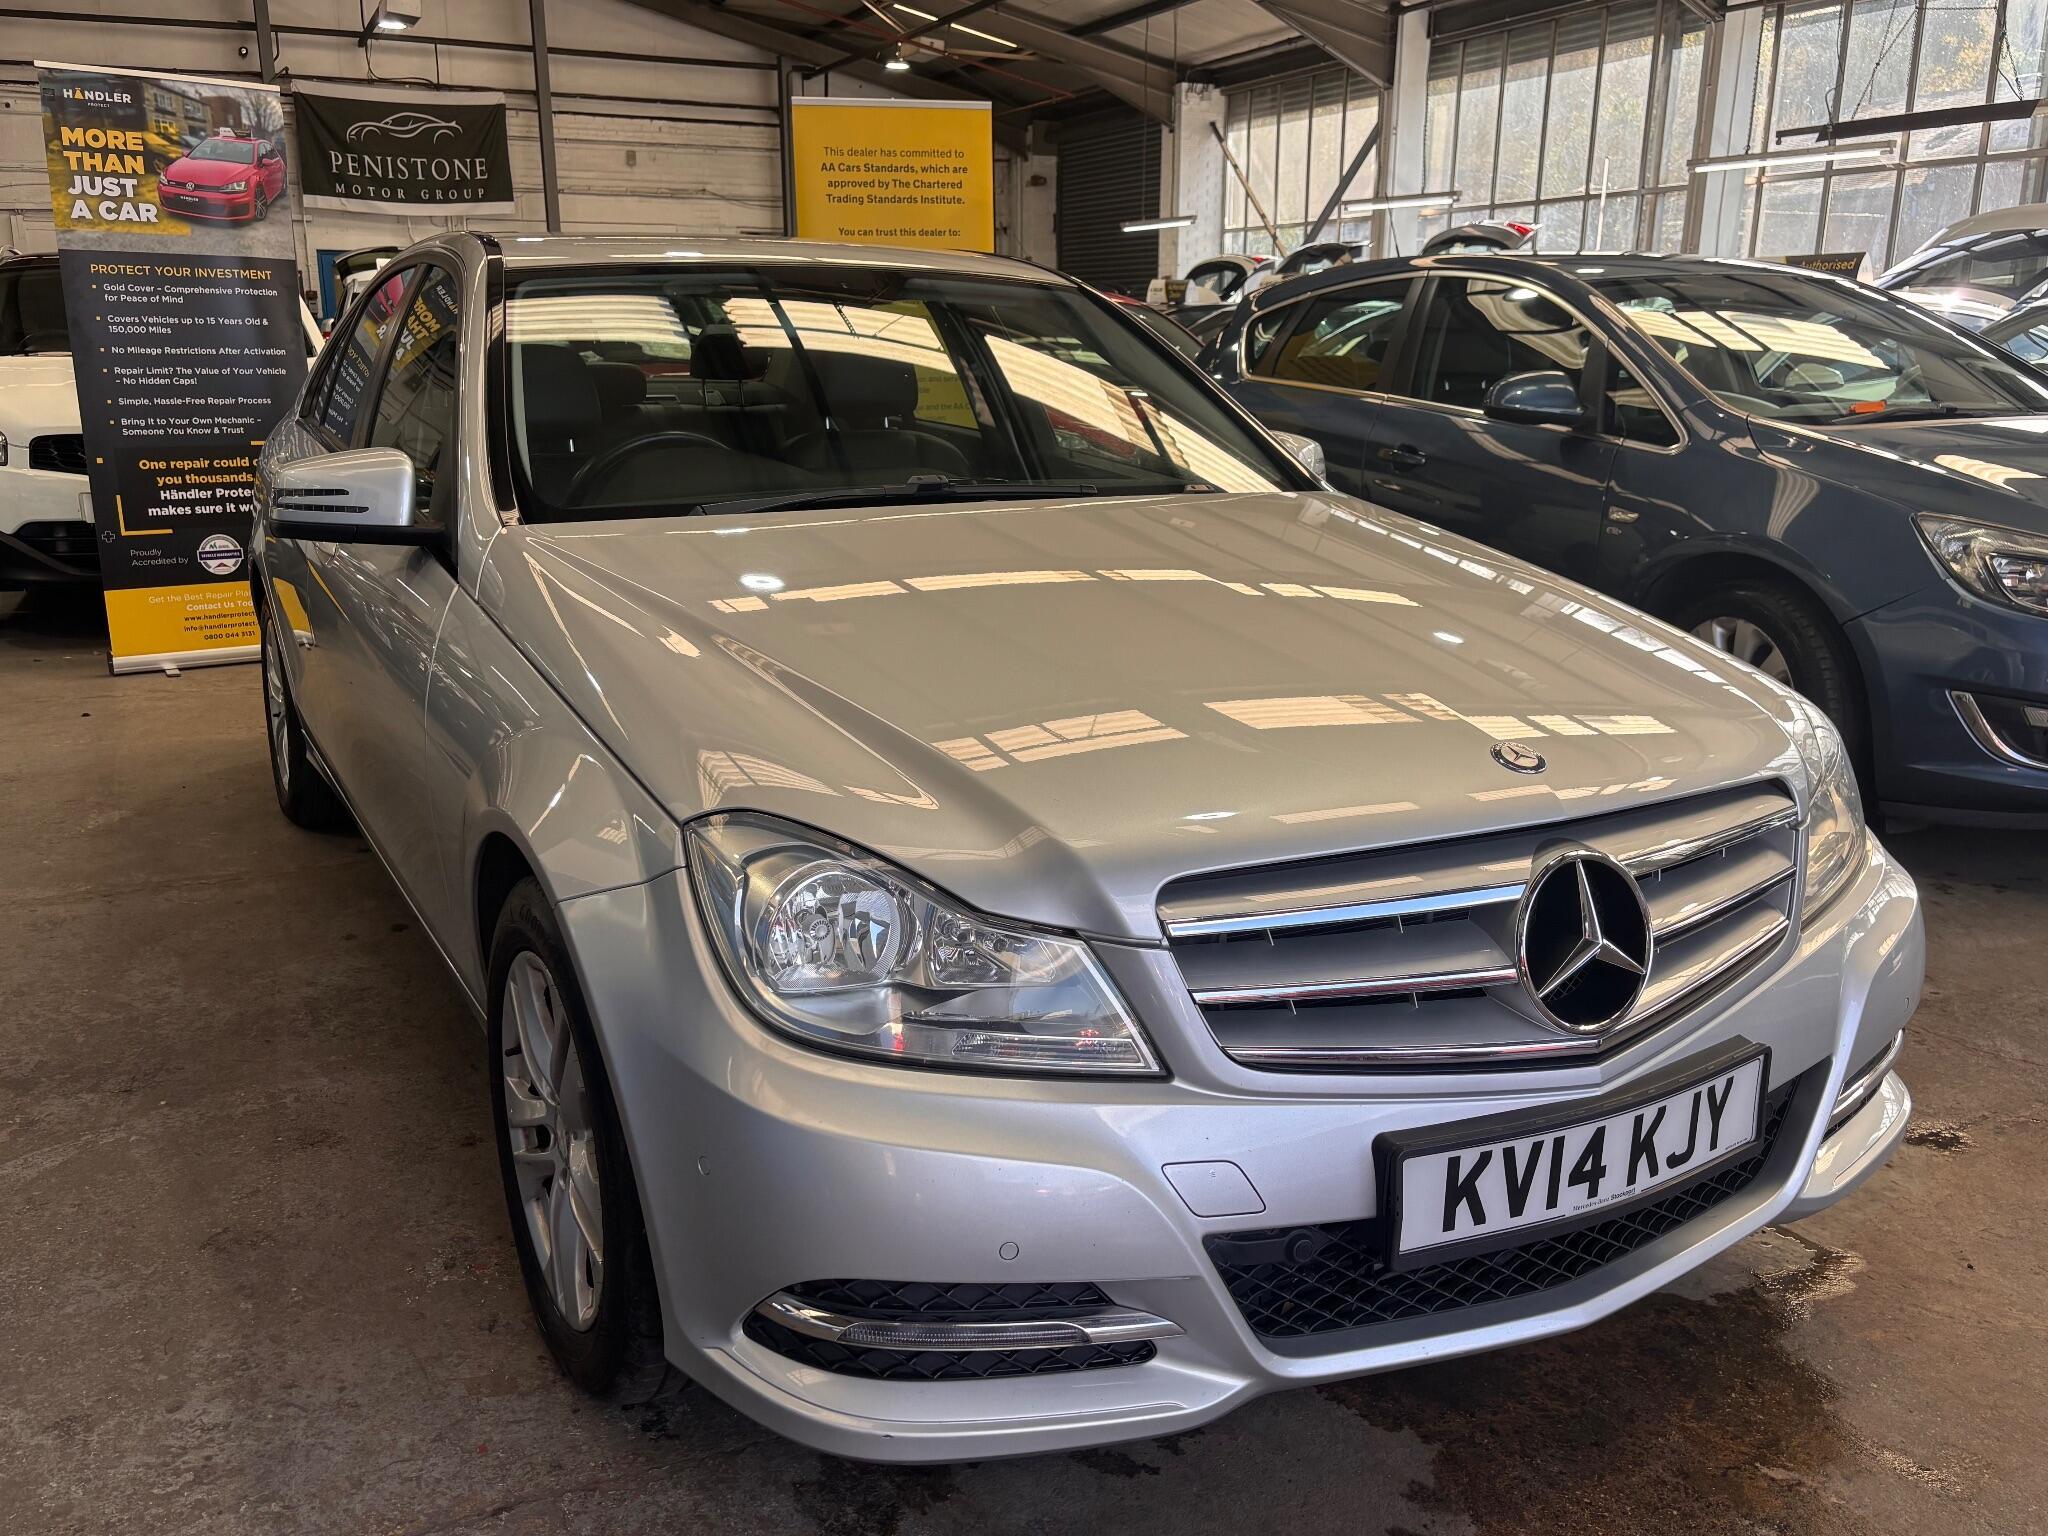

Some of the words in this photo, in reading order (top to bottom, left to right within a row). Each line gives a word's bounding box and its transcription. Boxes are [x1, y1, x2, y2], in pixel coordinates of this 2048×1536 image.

[60, 126, 144, 151] MORE
[824, 147, 844, 157] This
[847, 148, 877, 157] dealer
[880, 148, 897, 158] has
[900, 148, 951, 158] committed
[954, 150, 964, 158] to
[63, 151, 144, 174] THAN
[329, 151, 488, 181] PENISTONE
[820, 163, 835, 171] AA
[838, 163, 861, 172] Cars
[863, 164, 918, 174] Standards,
[921, 165, 950, 174] which
[952, 166, 968, 174] are
[68, 176, 138, 197] JUST
[827, 179, 875, 189] approved
[878, 180, 890, 190] by
[892, 180, 910, 189] The
[913, 180, 962, 189] Chartered
[335, 183, 405, 199] MOTOR
[421, 188, 484, 200] GROUP
[826, 195, 864, 206] Trading
[867, 195, 918, 204] Standards
[920, 196, 965, 205] Institute.
[71, 200, 93, 219] A
[98, 200, 159, 222] CAR
[838, 228, 855, 237] You
[876, 229, 897, 237] trust
[900, 228, 916, 237] this
[918, 228, 946, 237] dealer
[948, 229, 960, 237] to:
[90, 264, 150, 276] PROTECT
[155, 266, 191, 277] YOUR
[195, 268, 272, 280] INVESTMENT
[103, 284, 125, 292] Gold
[128, 284, 154, 292] Cover
[164, 286, 232, 295] Comprehensive
[235, 288, 278, 296] Protection
[107, 315, 139, 323] Covers
[142, 316, 179, 324] Vehicles
[181, 317, 192, 325] up
[206, 317, 215, 325] 15
[245, 318, 260, 326] Old
[108, 326, 146, 334] 150,000
[149, 326, 172, 334] Miles
[112, 346, 125, 354] No
[127, 346, 162, 355] Mileage
[164, 347, 216, 355] Restrictions
[219, 347, 240, 355] After
[114, 367, 144, 376] Repair
[146, 367, 173, 375] Limit?
[176, 367, 192, 375] The
[195, 367, 219, 375] Value
[233, 367, 254, 375] Your
[173, 377, 197, 385] Caps!
[118, 397, 152, 406] Simple,
[154, 398, 205, 406] Hassle-Free
[208, 398, 236, 406] Repair
[238, 397, 271, 405] Process
[121, 418, 146, 427] Bring
[168, 417, 190, 425] Your
[187, 427, 211, 435] Know
[222, 426, 244, 434] Trust
[139, 459, 167, 470] One
[171, 458, 210, 470] repair
[214, 457, 249, 467] could
[157, 476, 182, 486] you
[161, 489, 212, 500] Händler
[148, 505, 191, 516] makes
[195, 505, 223, 514] sure
[226, 503, 239, 513] it
[131, 549, 162, 557] Proudly
[132, 558, 176, 566] Accredited
[149, 596, 164, 604] Get
[184, 593, 203, 601] Best
[206, 592, 233, 600] Repair
[187, 603, 221, 611] Contact
[1442, 1126, 1607, 1233] KV14
[1626, 1075, 1734, 1187] KJY
[1610, 1187, 1636, 1201] Stockport
